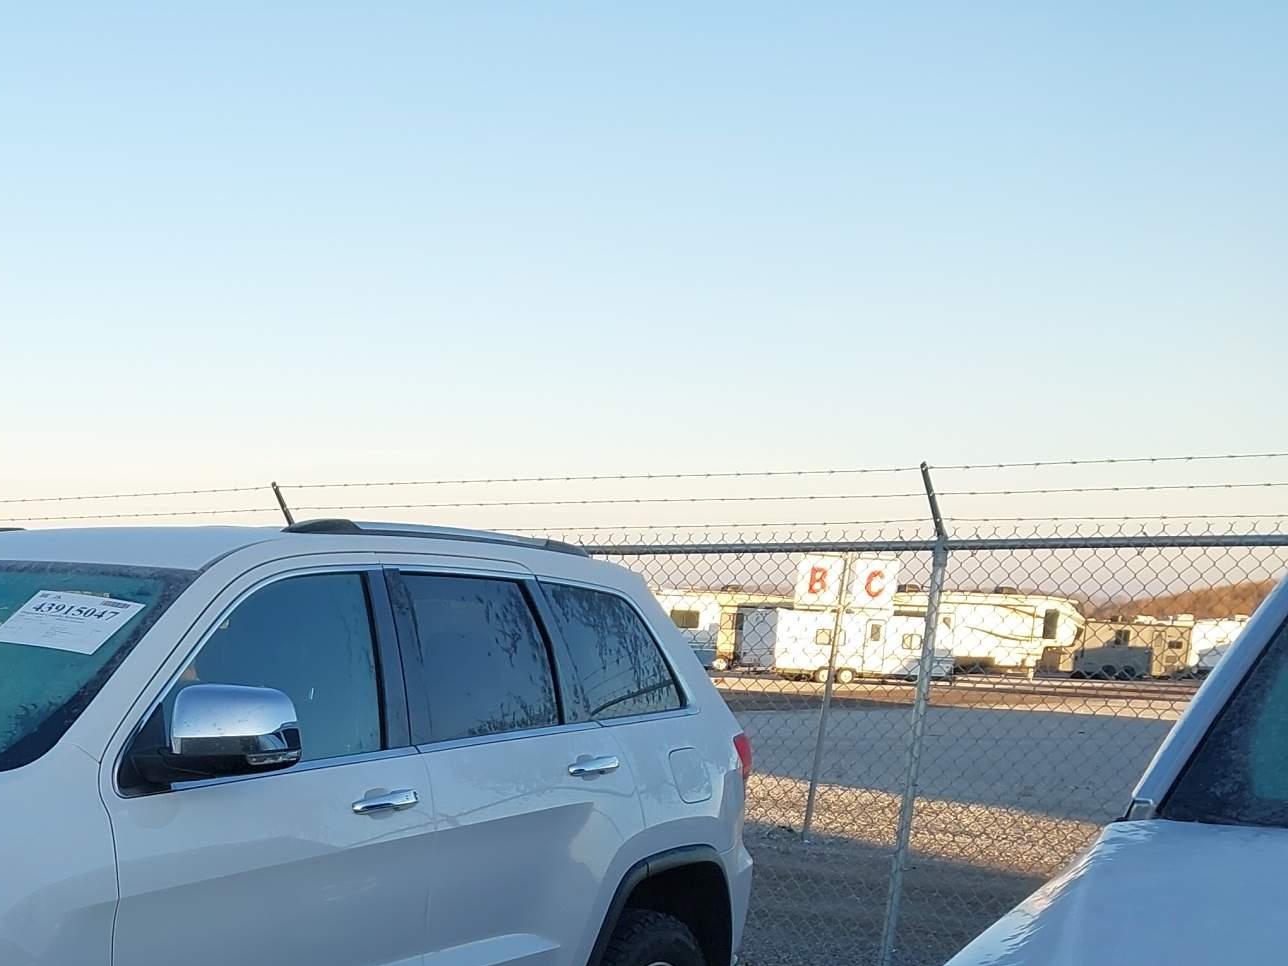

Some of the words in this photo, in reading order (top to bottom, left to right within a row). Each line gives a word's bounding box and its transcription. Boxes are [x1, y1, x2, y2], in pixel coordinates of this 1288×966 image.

[808, 566, 828, 595] B
[864, 570, 885, 598] C
[32, 601, 120, 621] 43915047
